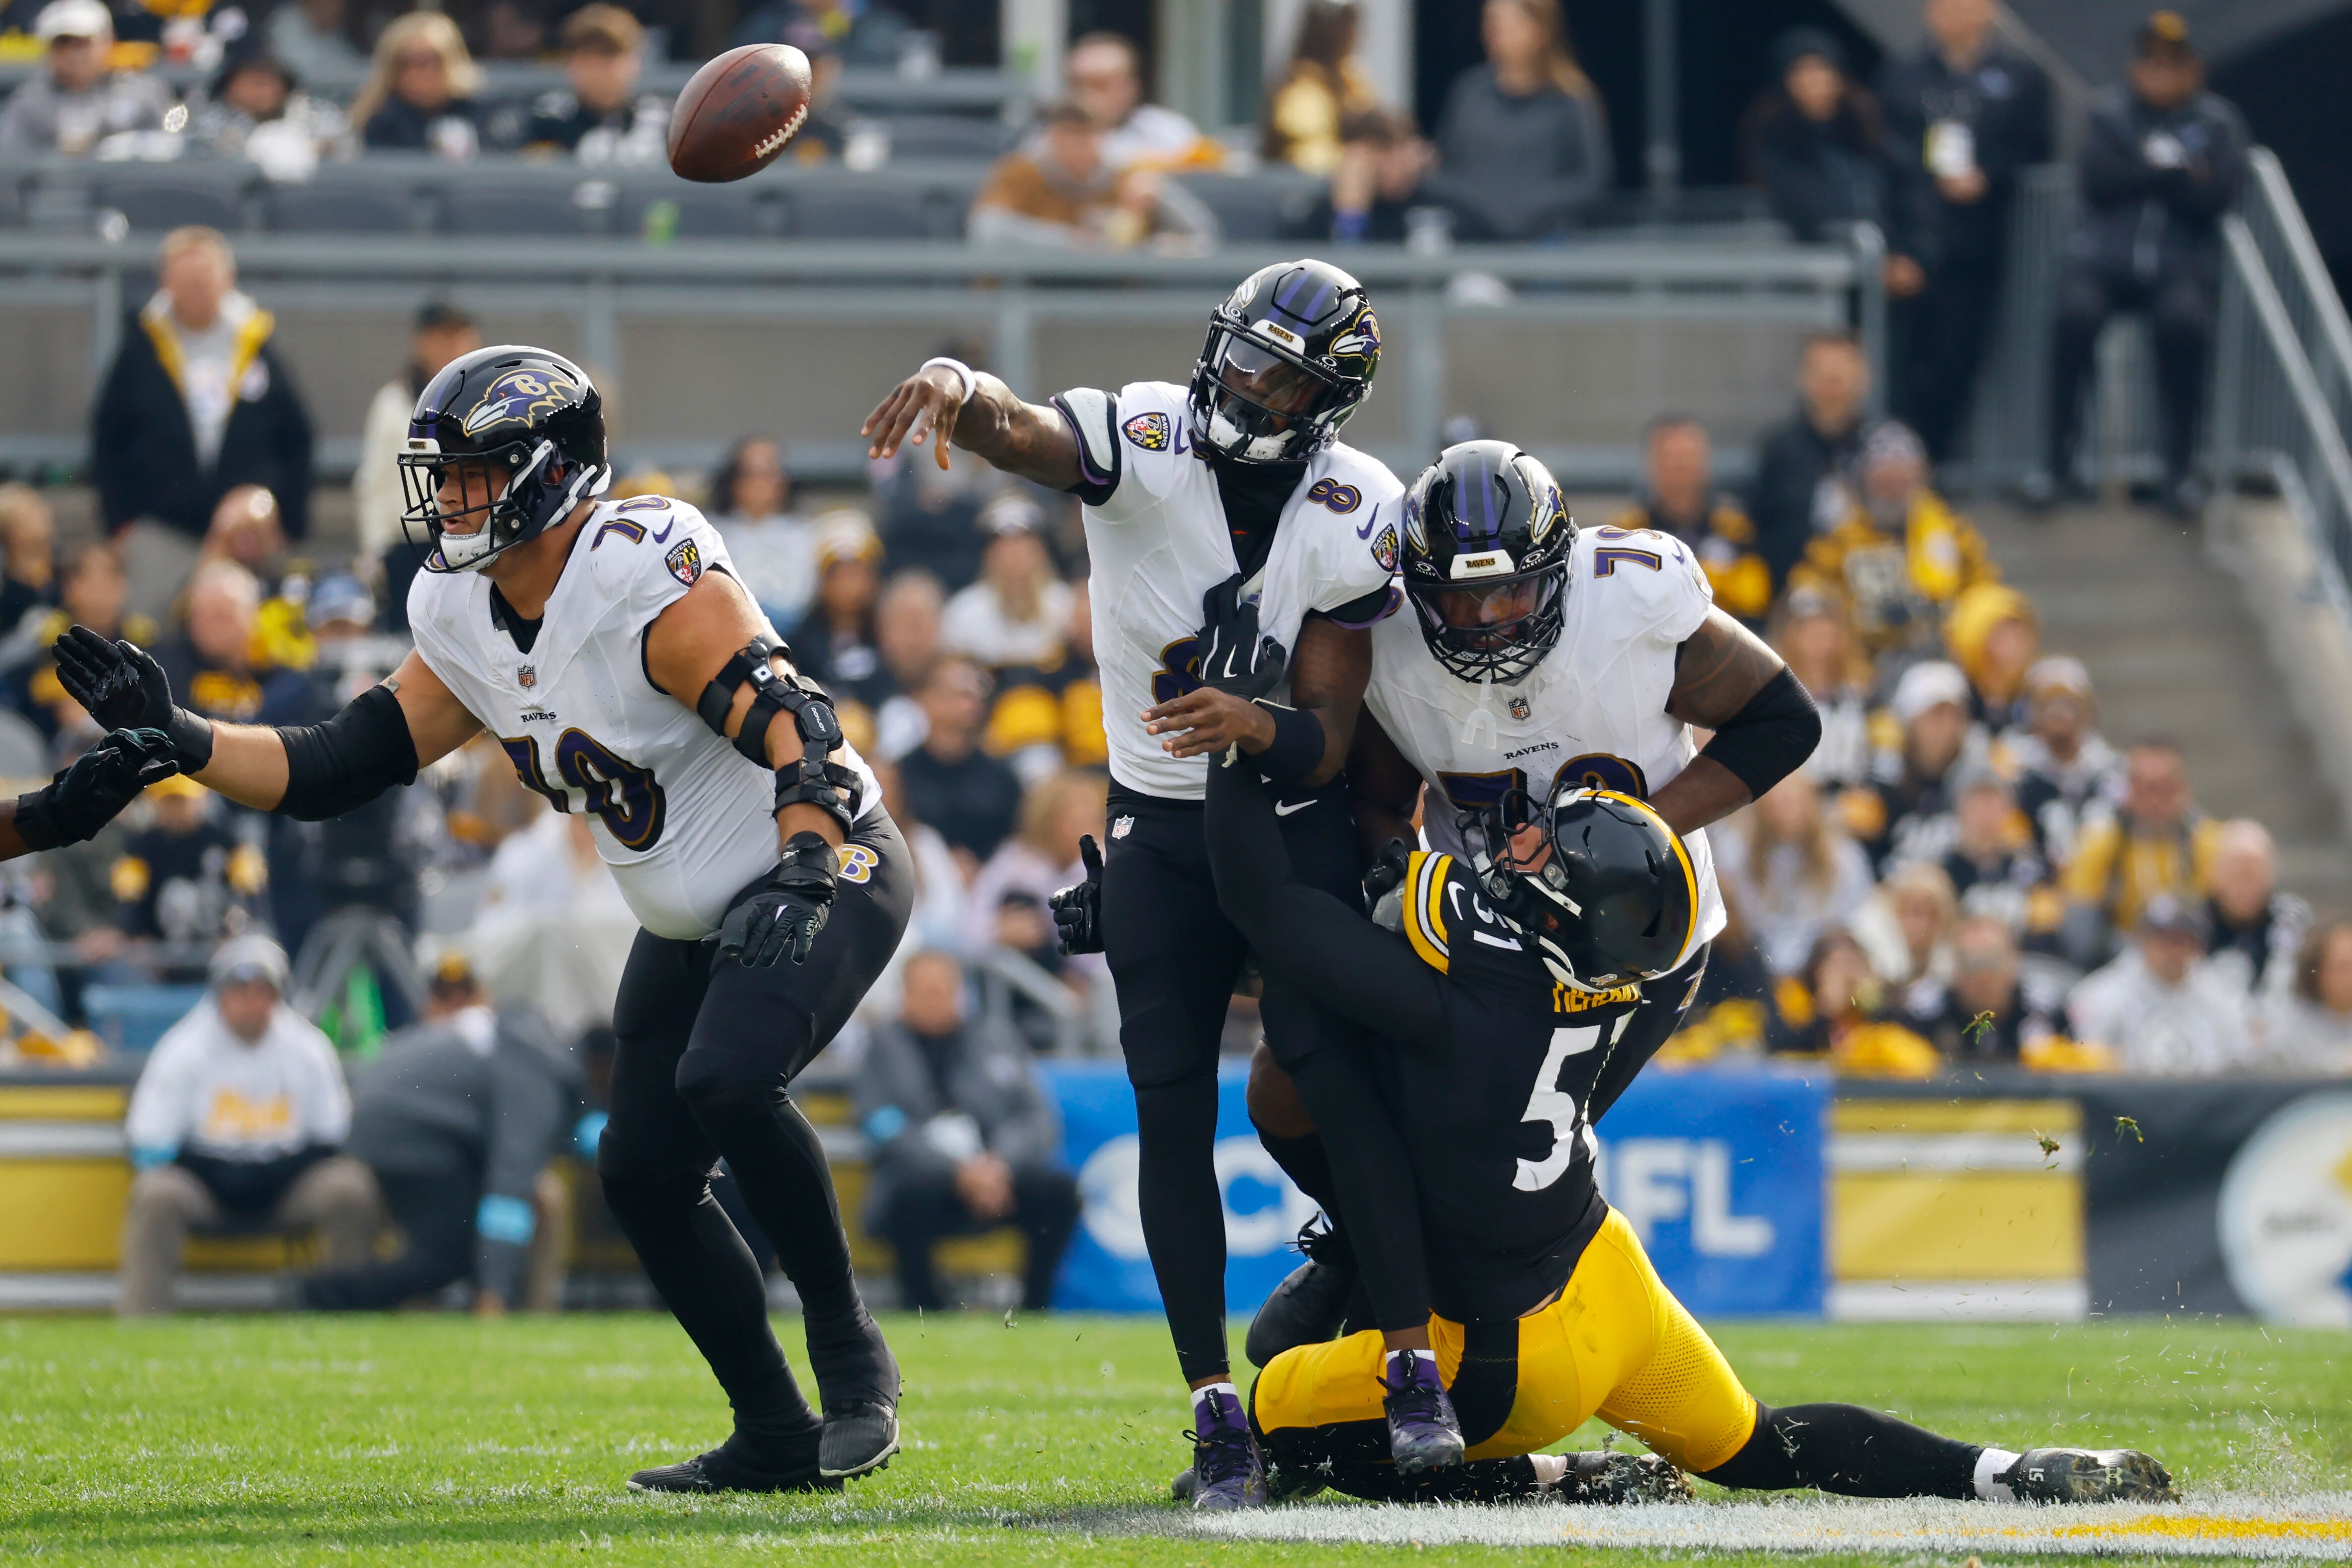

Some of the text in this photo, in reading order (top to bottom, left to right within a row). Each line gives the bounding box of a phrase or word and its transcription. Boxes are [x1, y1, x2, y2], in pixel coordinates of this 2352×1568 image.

[1267, 323, 1295, 344] RAVENS
[1306, 477, 1362, 515] 8
[590, 496, 672, 552] 70
[1373, 526, 1392, 550] RAVENS
[666, 539, 692, 562] RAVENS
[1465, 557, 1495, 569] RAVENS
[1522, 556, 1544, 570] OAKLEY
[520, 674, 534, 685] NFL
[521, 711, 556, 722] RAVENS
[811, 707, 827, 733] DONJOY
[1513, 706, 1528, 719] NFL
[1503, 741, 1559, 760] RAVENS
[489, 726, 667, 852] 70
[1114, 826, 1129, 835] NFL
[837, 843, 879, 884] B
[1592, 1135, 1776, 1256] FL
[2029, 1468, 2044, 1482] 51
